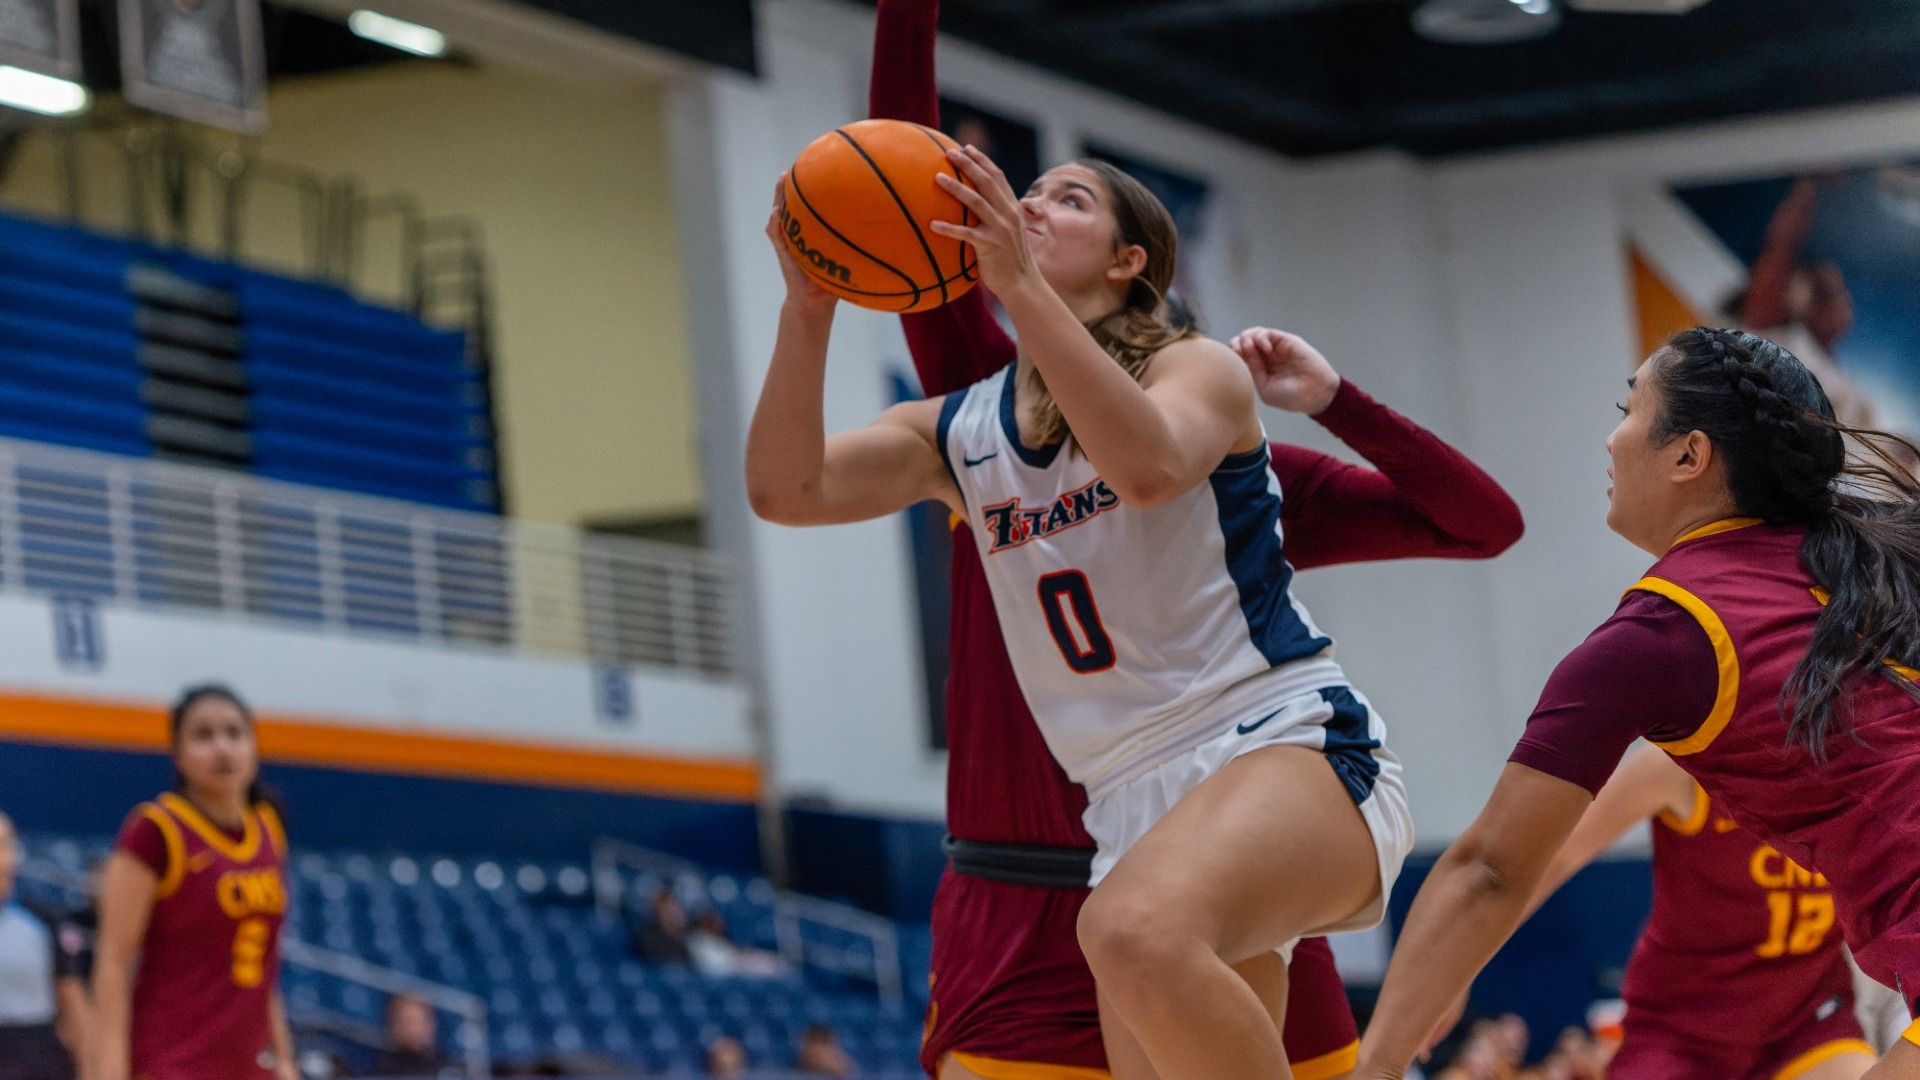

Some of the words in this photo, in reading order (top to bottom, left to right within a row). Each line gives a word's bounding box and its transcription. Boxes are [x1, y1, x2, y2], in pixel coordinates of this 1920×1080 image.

[780, 202, 852, 283] ilson
[982, 477, 1120, 554] TITANS
[1038, 569, 1116, 674] 0
